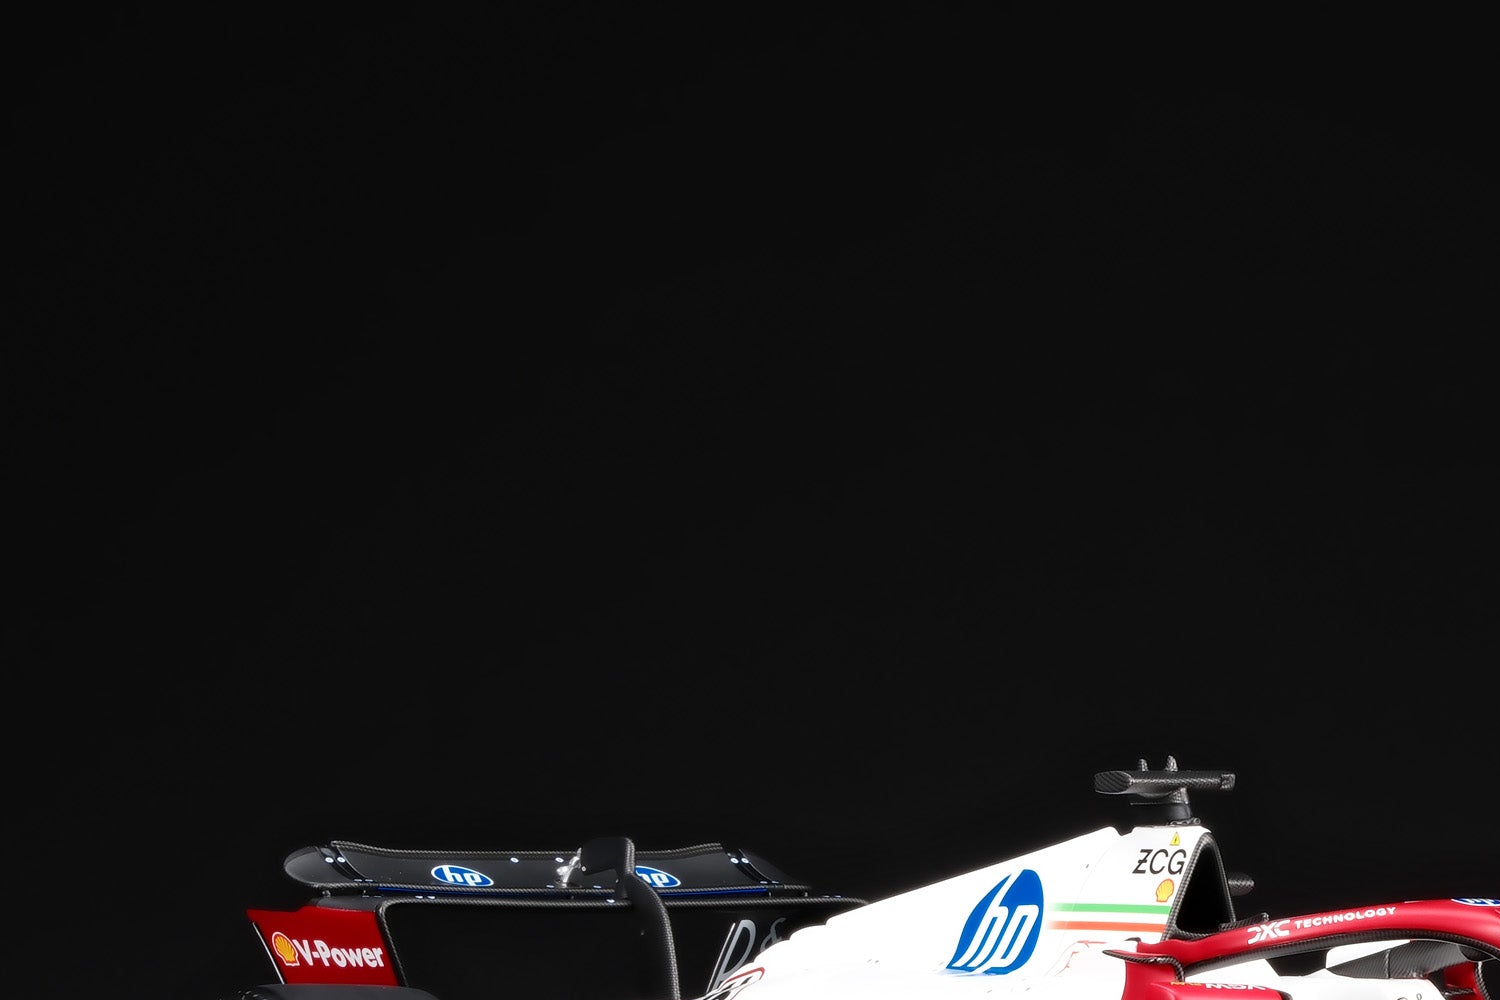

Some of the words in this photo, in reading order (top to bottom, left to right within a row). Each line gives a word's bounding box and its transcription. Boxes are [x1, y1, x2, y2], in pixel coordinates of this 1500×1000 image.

[441, 864, 488, 887] hp
[948, 869, 1042, 976] hp
[1247, 919, 1291, 945] DXC
[1294, 906, 1397, 930] TECHNOLOGY
[292, 940, 384, 968] V-Power
